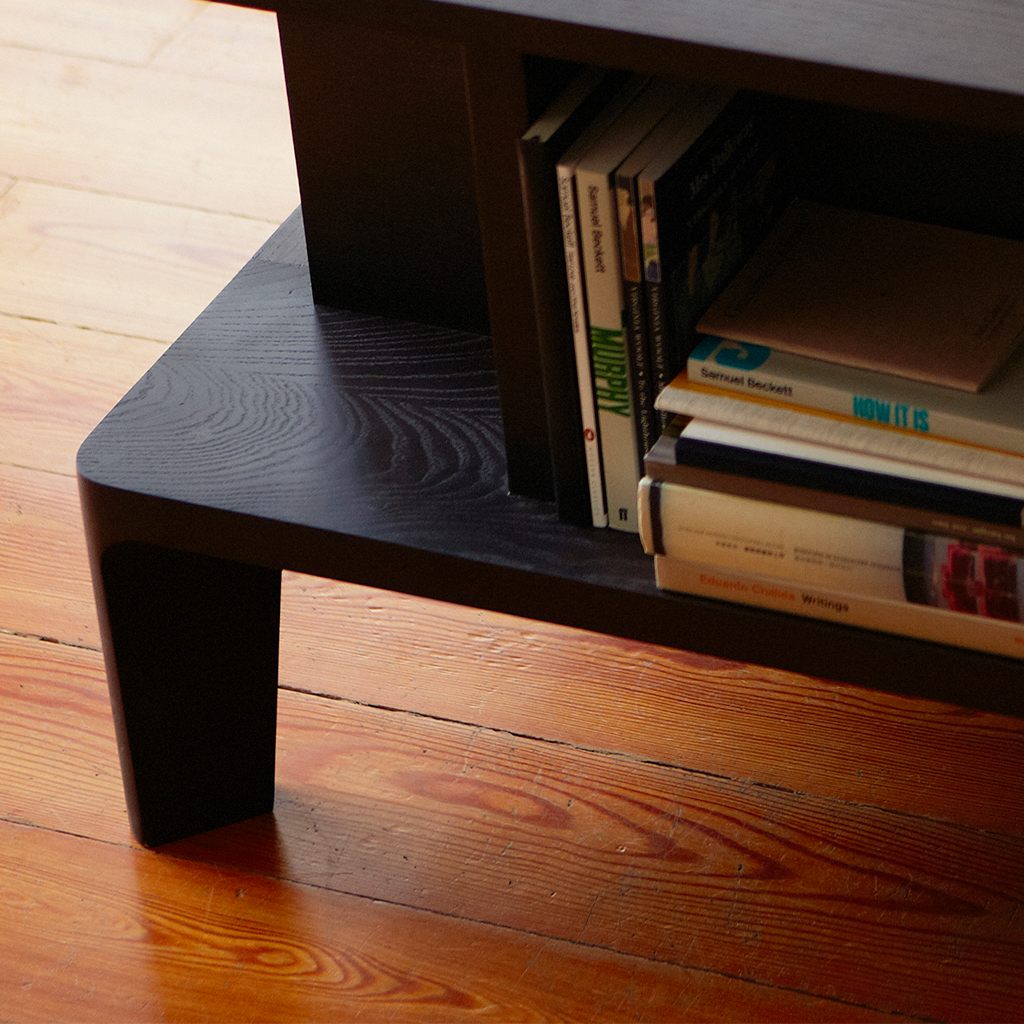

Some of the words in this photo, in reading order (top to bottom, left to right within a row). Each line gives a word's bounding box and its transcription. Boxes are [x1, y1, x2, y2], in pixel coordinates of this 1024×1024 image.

[588, 185, 602, 227] Samuel
[592, 229, 605, 274] Beckett
[591, 325, 631, 417] MURPHY
[700, 367, 744, 386] Samuel
[747, 377, 793, 397] Beckett
[853, 394, 891, 424] HOW
[894, 403, 910, 428] IT
[913, 406, 930, 433] IS
[699, 573, 748, 592] Eduardo
[751, 584, 796, 601] Chillida
[801, 593, 850, 613] Writings
